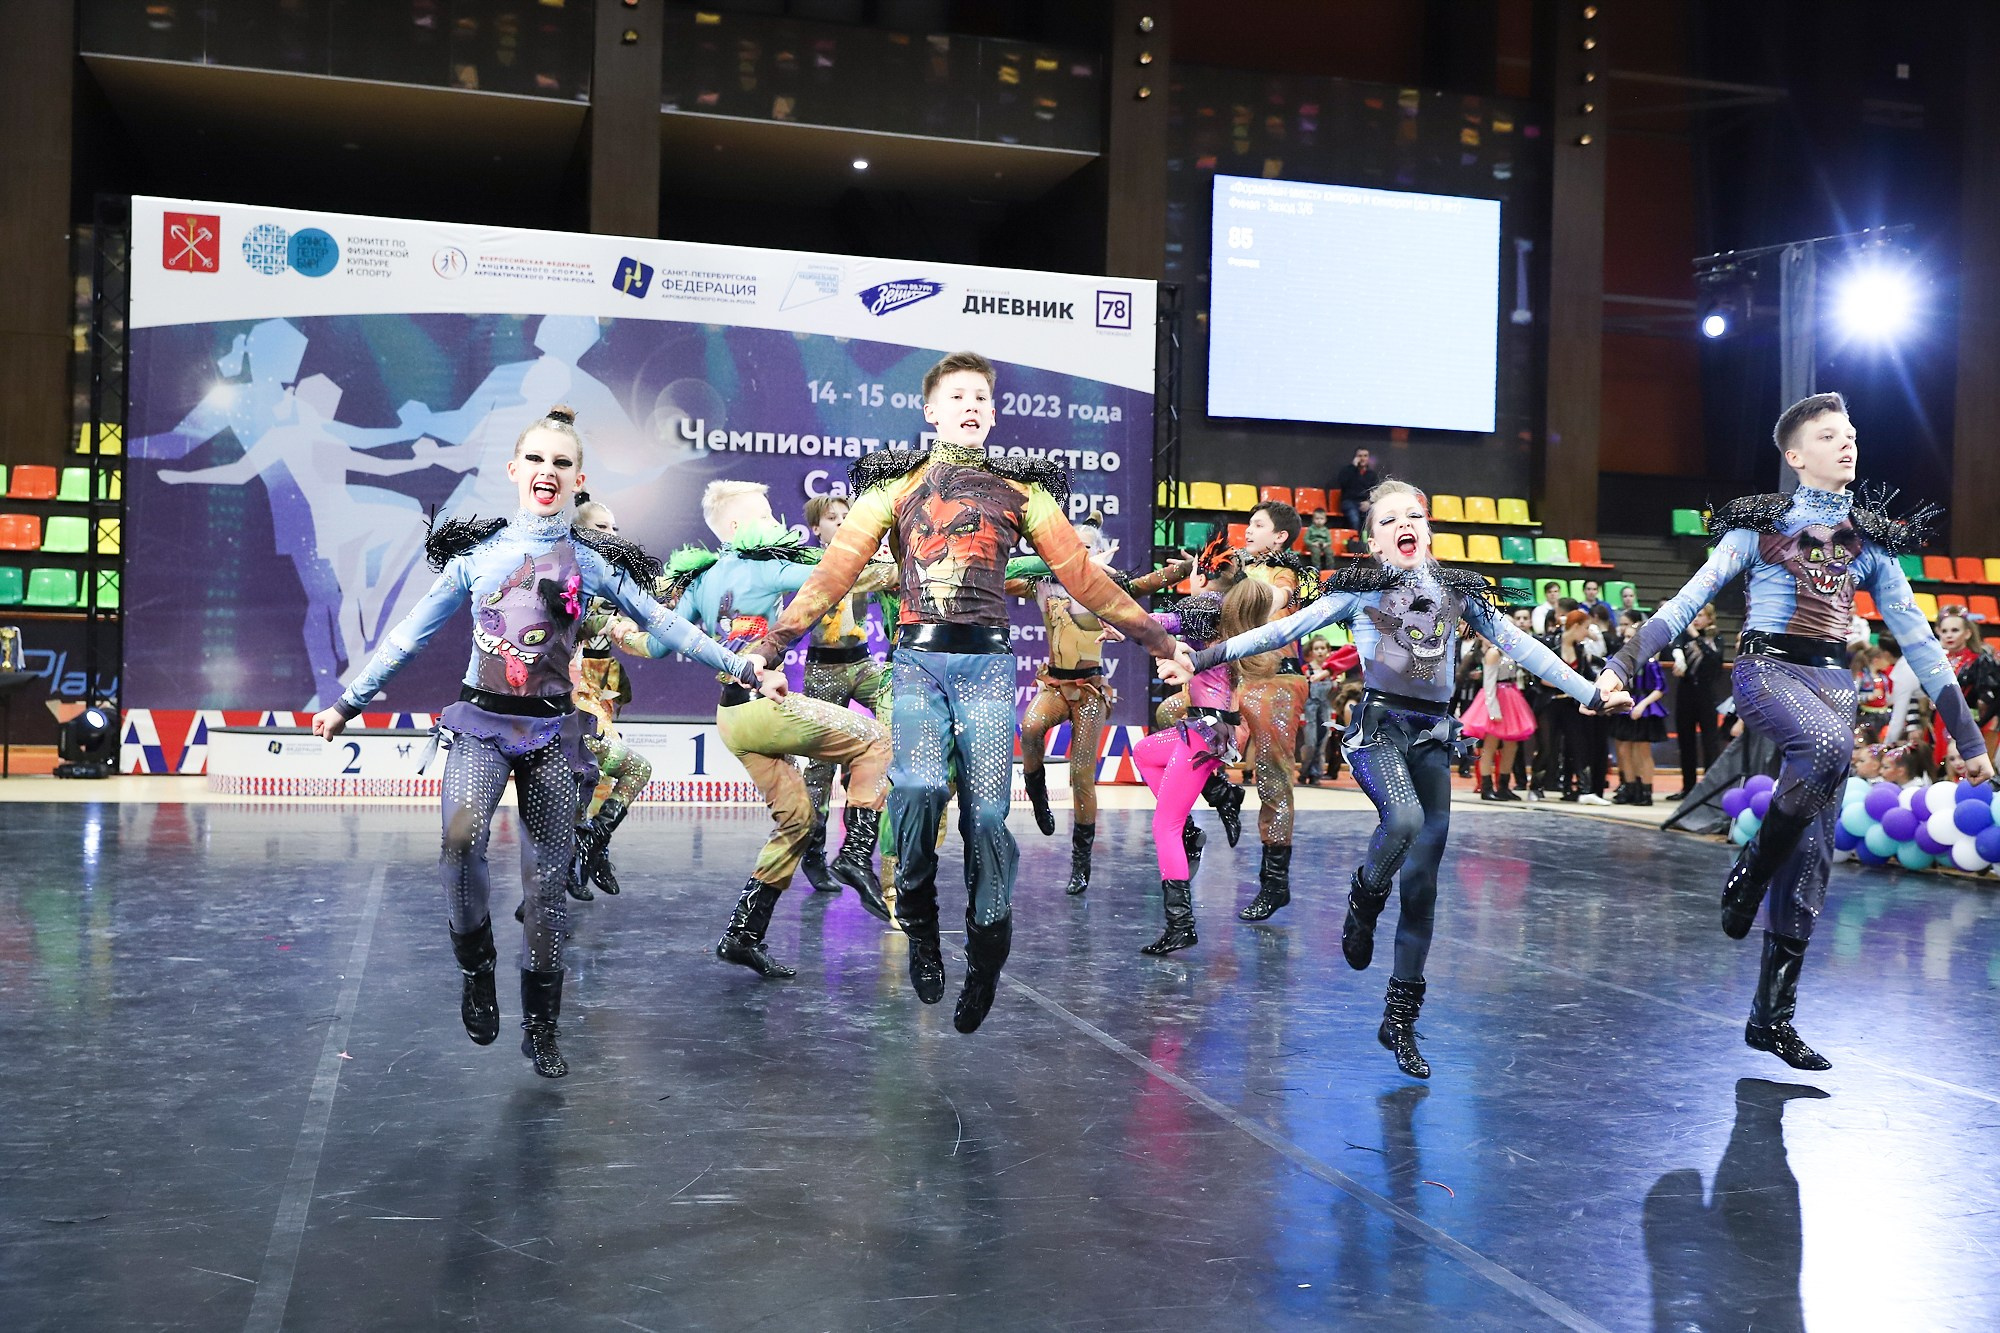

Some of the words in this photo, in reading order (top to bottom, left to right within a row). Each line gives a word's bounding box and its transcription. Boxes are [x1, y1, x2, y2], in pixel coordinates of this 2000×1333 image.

[347, 237, 389, 247] КОМИТЕТ
[392, 239, 406, 248] ПО
[1228, 226, 1253, 249] 85
[347, 247, 409, 258] ФИЗИЧЕСКОЙ
[347, 257, 389, 267] КУЛЬТУРЕ
[477, 263, 549, 273] ТАНЦЕВАЛЬНОГО
[480, 256, 544, 265] ВСЕРОССИЙСКАЯ
[547, 261, 591, 269] ФЕДЕРАЦИЯ
[356, 269, 392, 278] СПОРТУ
[474, 271, 544, 281] АКРОБАТИЧЕСКОГО
[662, 268, 757, 282] САНКТ-ПЕТЕРБУРГСКАЯ
[662, 278, 757, 297] ФЕДЕРАЦИЯ
[870, 285, 931, 315] Зенит
[962, 295, 1074, 320] ДНЕВНИК
[1102, 300, 1126, 320] 78
[808, 380, 837, 405] 14
[843, 392, 852, 400] -
[857, 383, 885, 408] 15
[1001, 392, 1061, 418] 2023
[1068, 403, 1122, 425] года
[680, 418, 880, 458] Чемпионат
[342, 742, 362, 774] 2
[689, 732, 711, 775] 1
